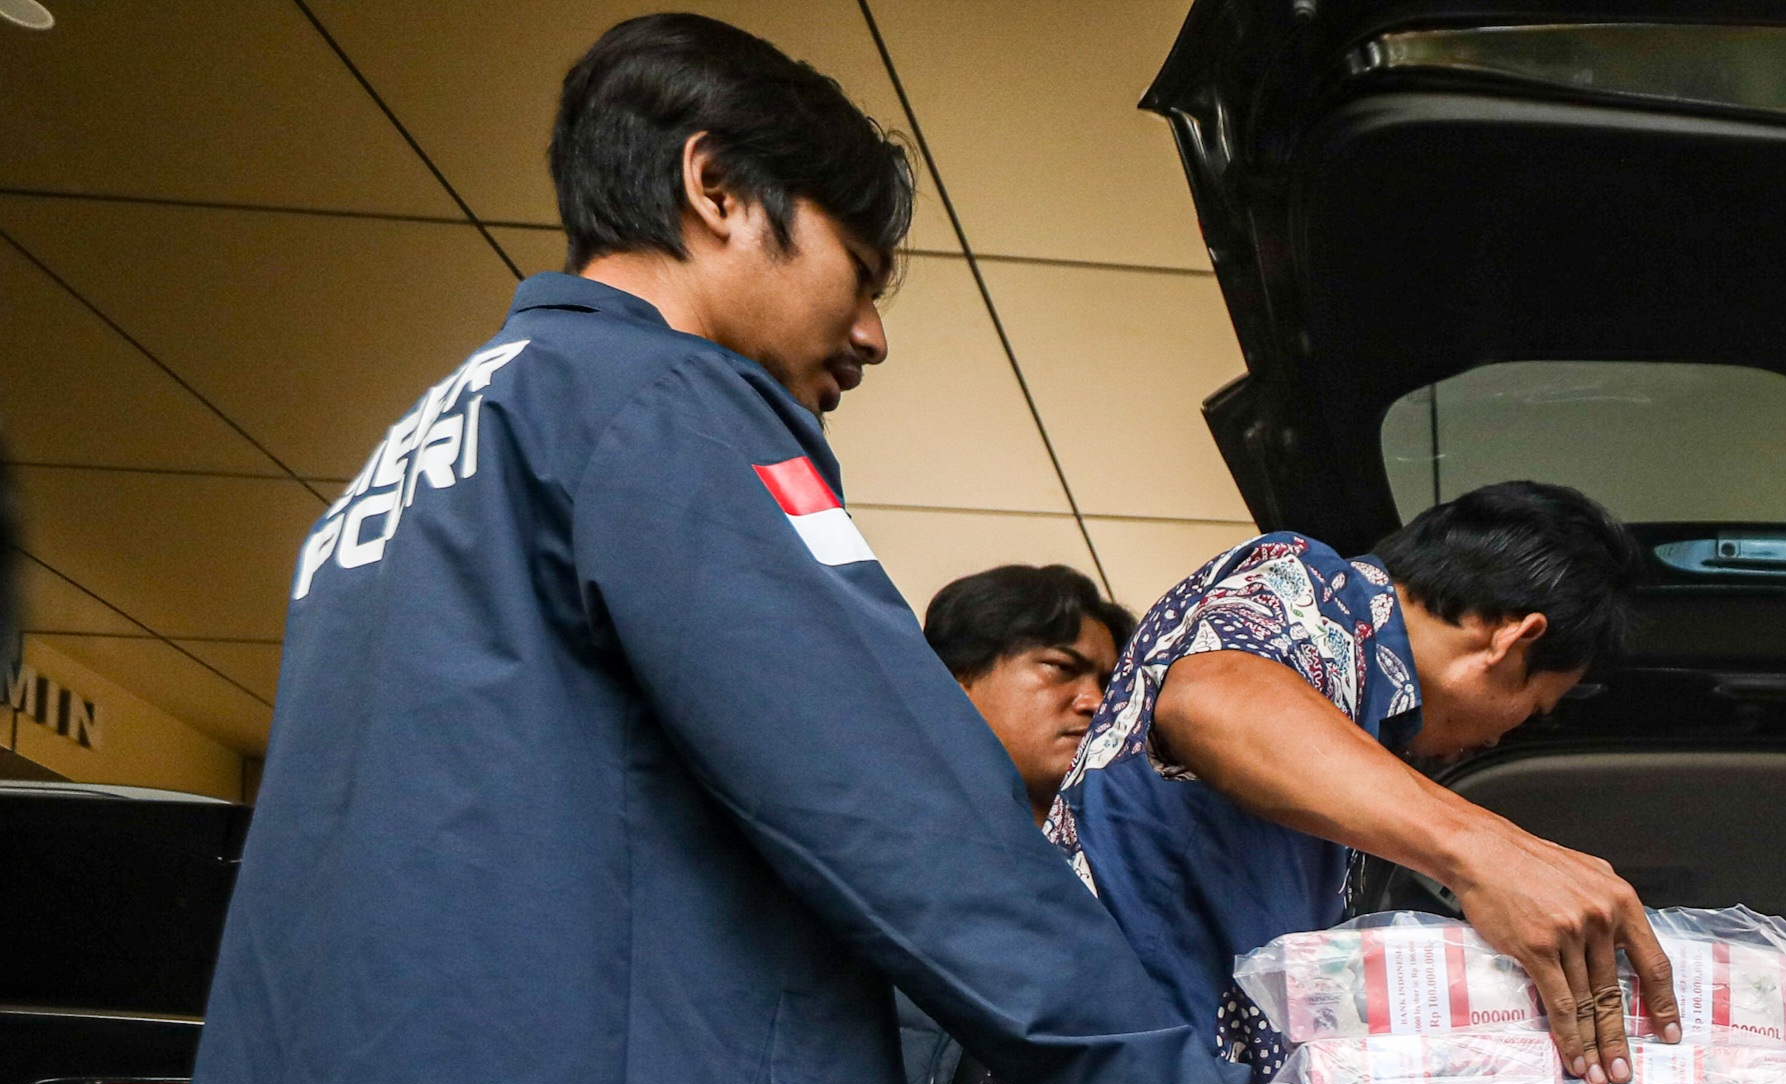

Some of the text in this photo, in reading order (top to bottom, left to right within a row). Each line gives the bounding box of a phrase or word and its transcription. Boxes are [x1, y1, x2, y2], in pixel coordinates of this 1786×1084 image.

[1396, 943, 1409, 1025] BANK INDONESIA
[1429, 1011, 1442, 1028] Rp
[1471, 1008, 1525, 1026] 100000
